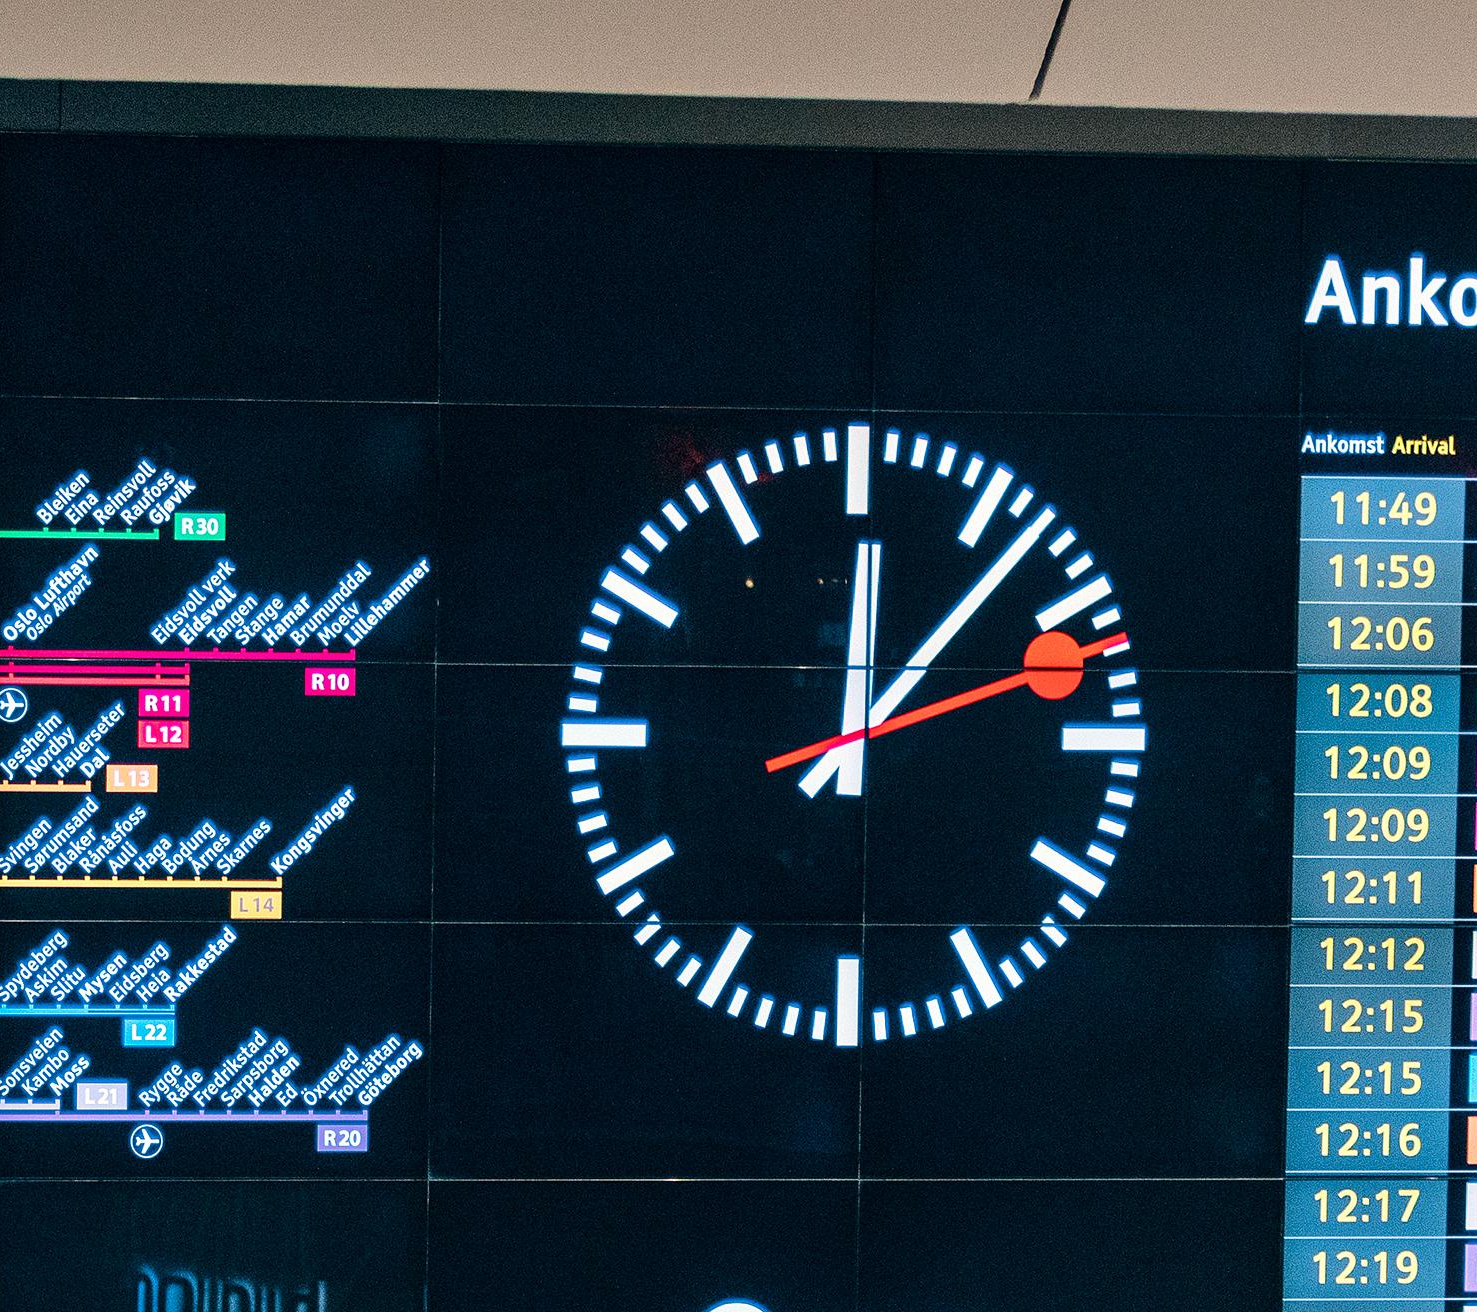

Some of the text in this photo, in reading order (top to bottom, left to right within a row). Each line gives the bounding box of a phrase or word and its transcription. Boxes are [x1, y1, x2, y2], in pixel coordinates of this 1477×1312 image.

[1302, 434, 1455, 455] Ankomst Arrival
[37, 474, 89, 523] Bleiken
[150, 480, 195, 524] Gjøvik
[1331, 492, 1436, 525] 11:49
[1330, 555, 1434, 588] 11:59
[344, 560, 429, 645] Lillehammer
[1327, 684, 1432, 717] 12:08
[272, 790, 356, 874] Kongsvinger
[1324, 809, 1428, 842] 12:09
[163, 927, 236, 1002] Rakkestad
[359, 1044, 422, 1105] Göteborg
[1318, 1062, 1421, 1094] 12:15
[1315, 1190, 1419, 1222] 12:17
[1314, 1251, 1417, 1283] 12:19
